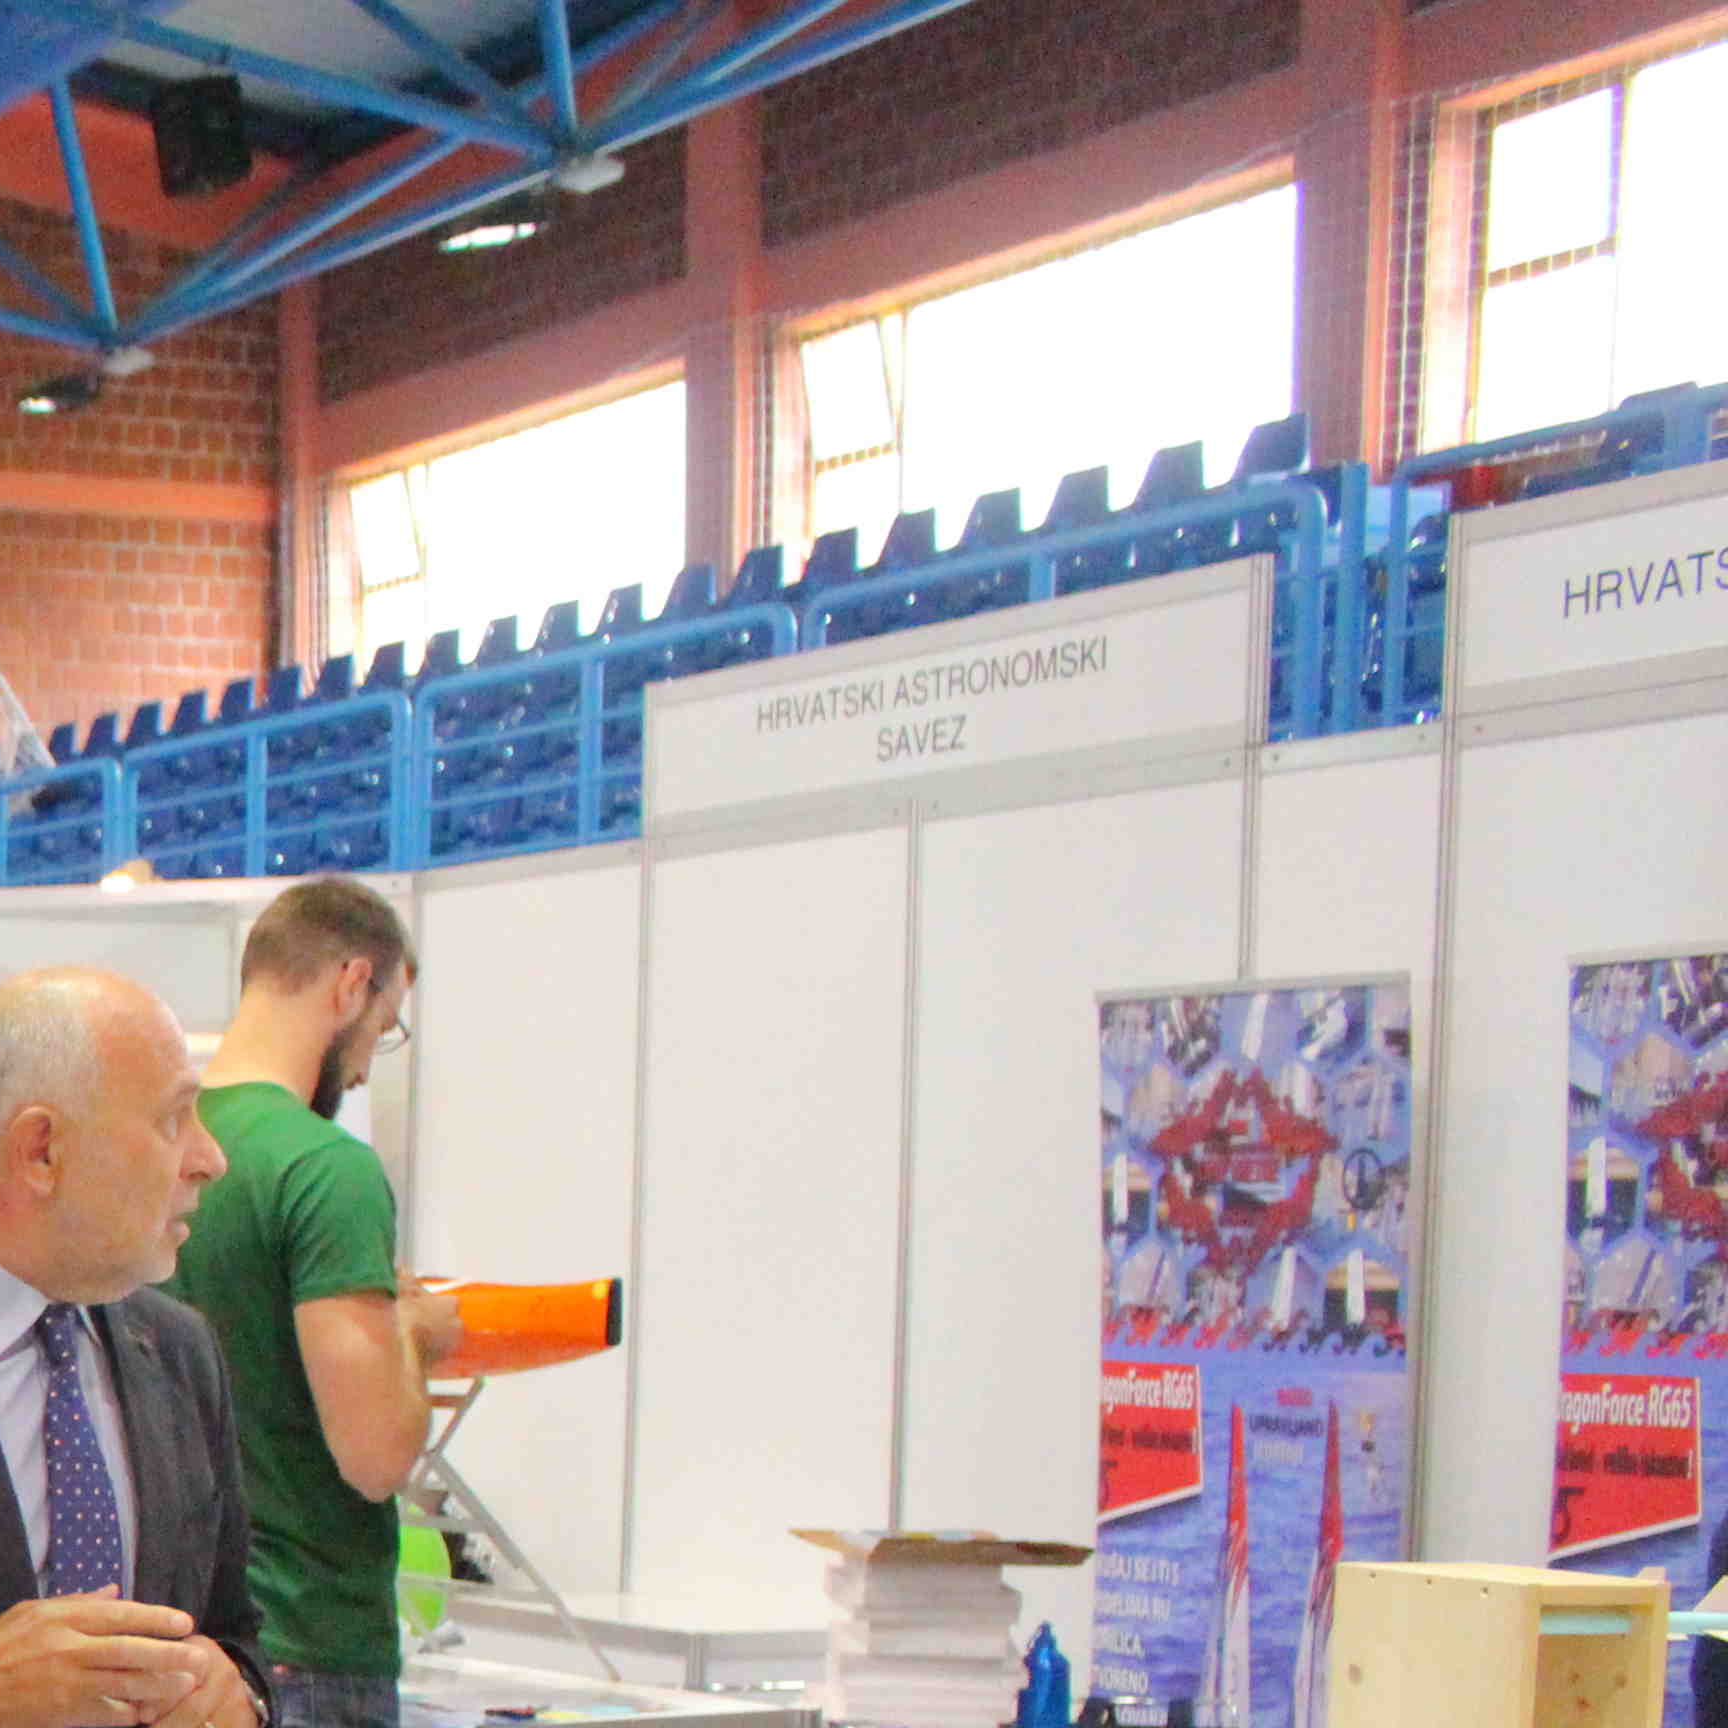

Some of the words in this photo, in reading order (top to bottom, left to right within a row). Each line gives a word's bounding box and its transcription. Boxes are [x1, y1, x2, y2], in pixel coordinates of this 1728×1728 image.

[755, 678, 885, 734] HRVATSKI
[893, 634, 1109, 708] ASTRONOMSKI
[876, 714, 968, 763] SAVEZ
[1648, 1384, 1692, 1428] RG65
